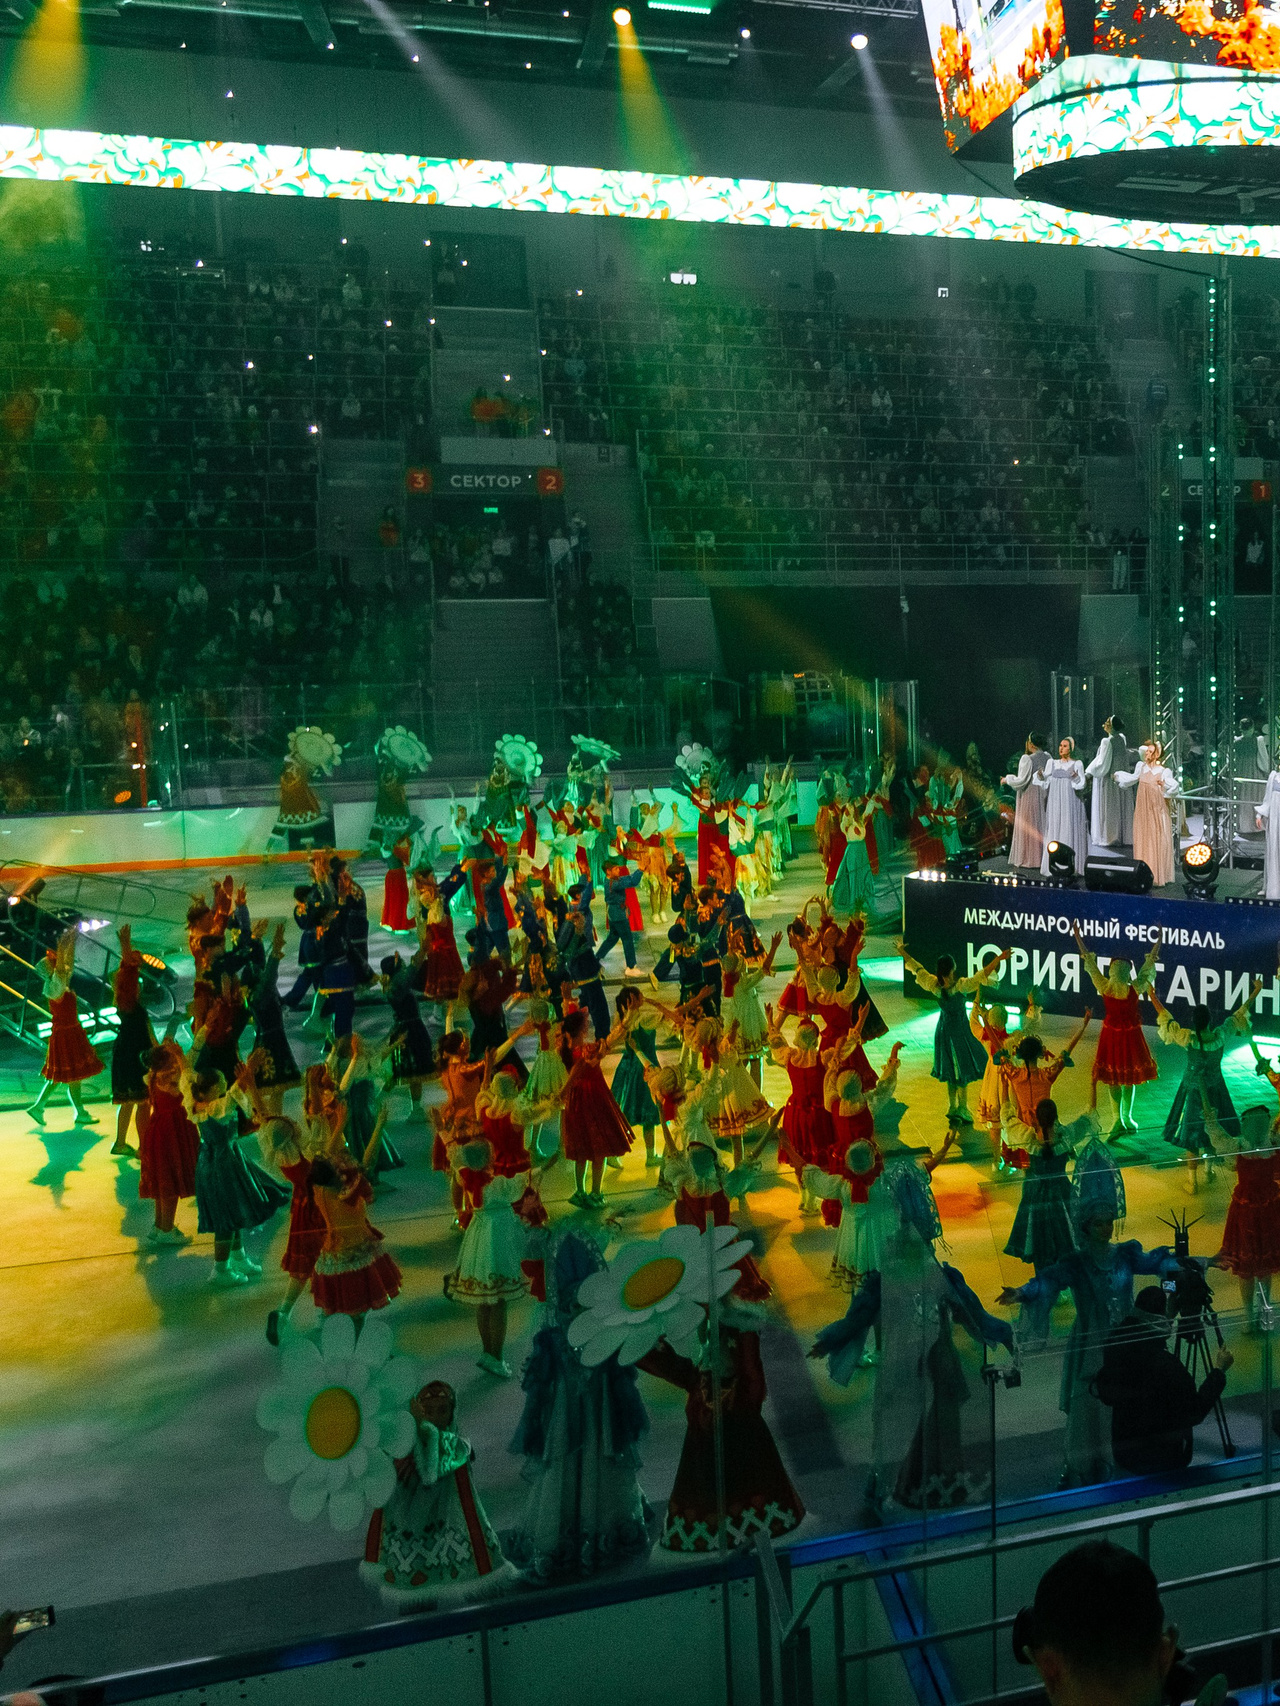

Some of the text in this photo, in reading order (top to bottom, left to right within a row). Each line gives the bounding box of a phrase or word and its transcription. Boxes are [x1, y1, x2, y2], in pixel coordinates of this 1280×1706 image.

[413, 473, 557, 490] 3 СЕКТОР 2
[1161, 485, 1170, 497] 2
[1187, 485, 1241, 496] СЕТР
[964, 907, 1225, 949] МЕЖДУНАРОДНЫЙ ФЕСТИВАЛЬ
[966, 942, 1080, 993] ЮРИЯ
